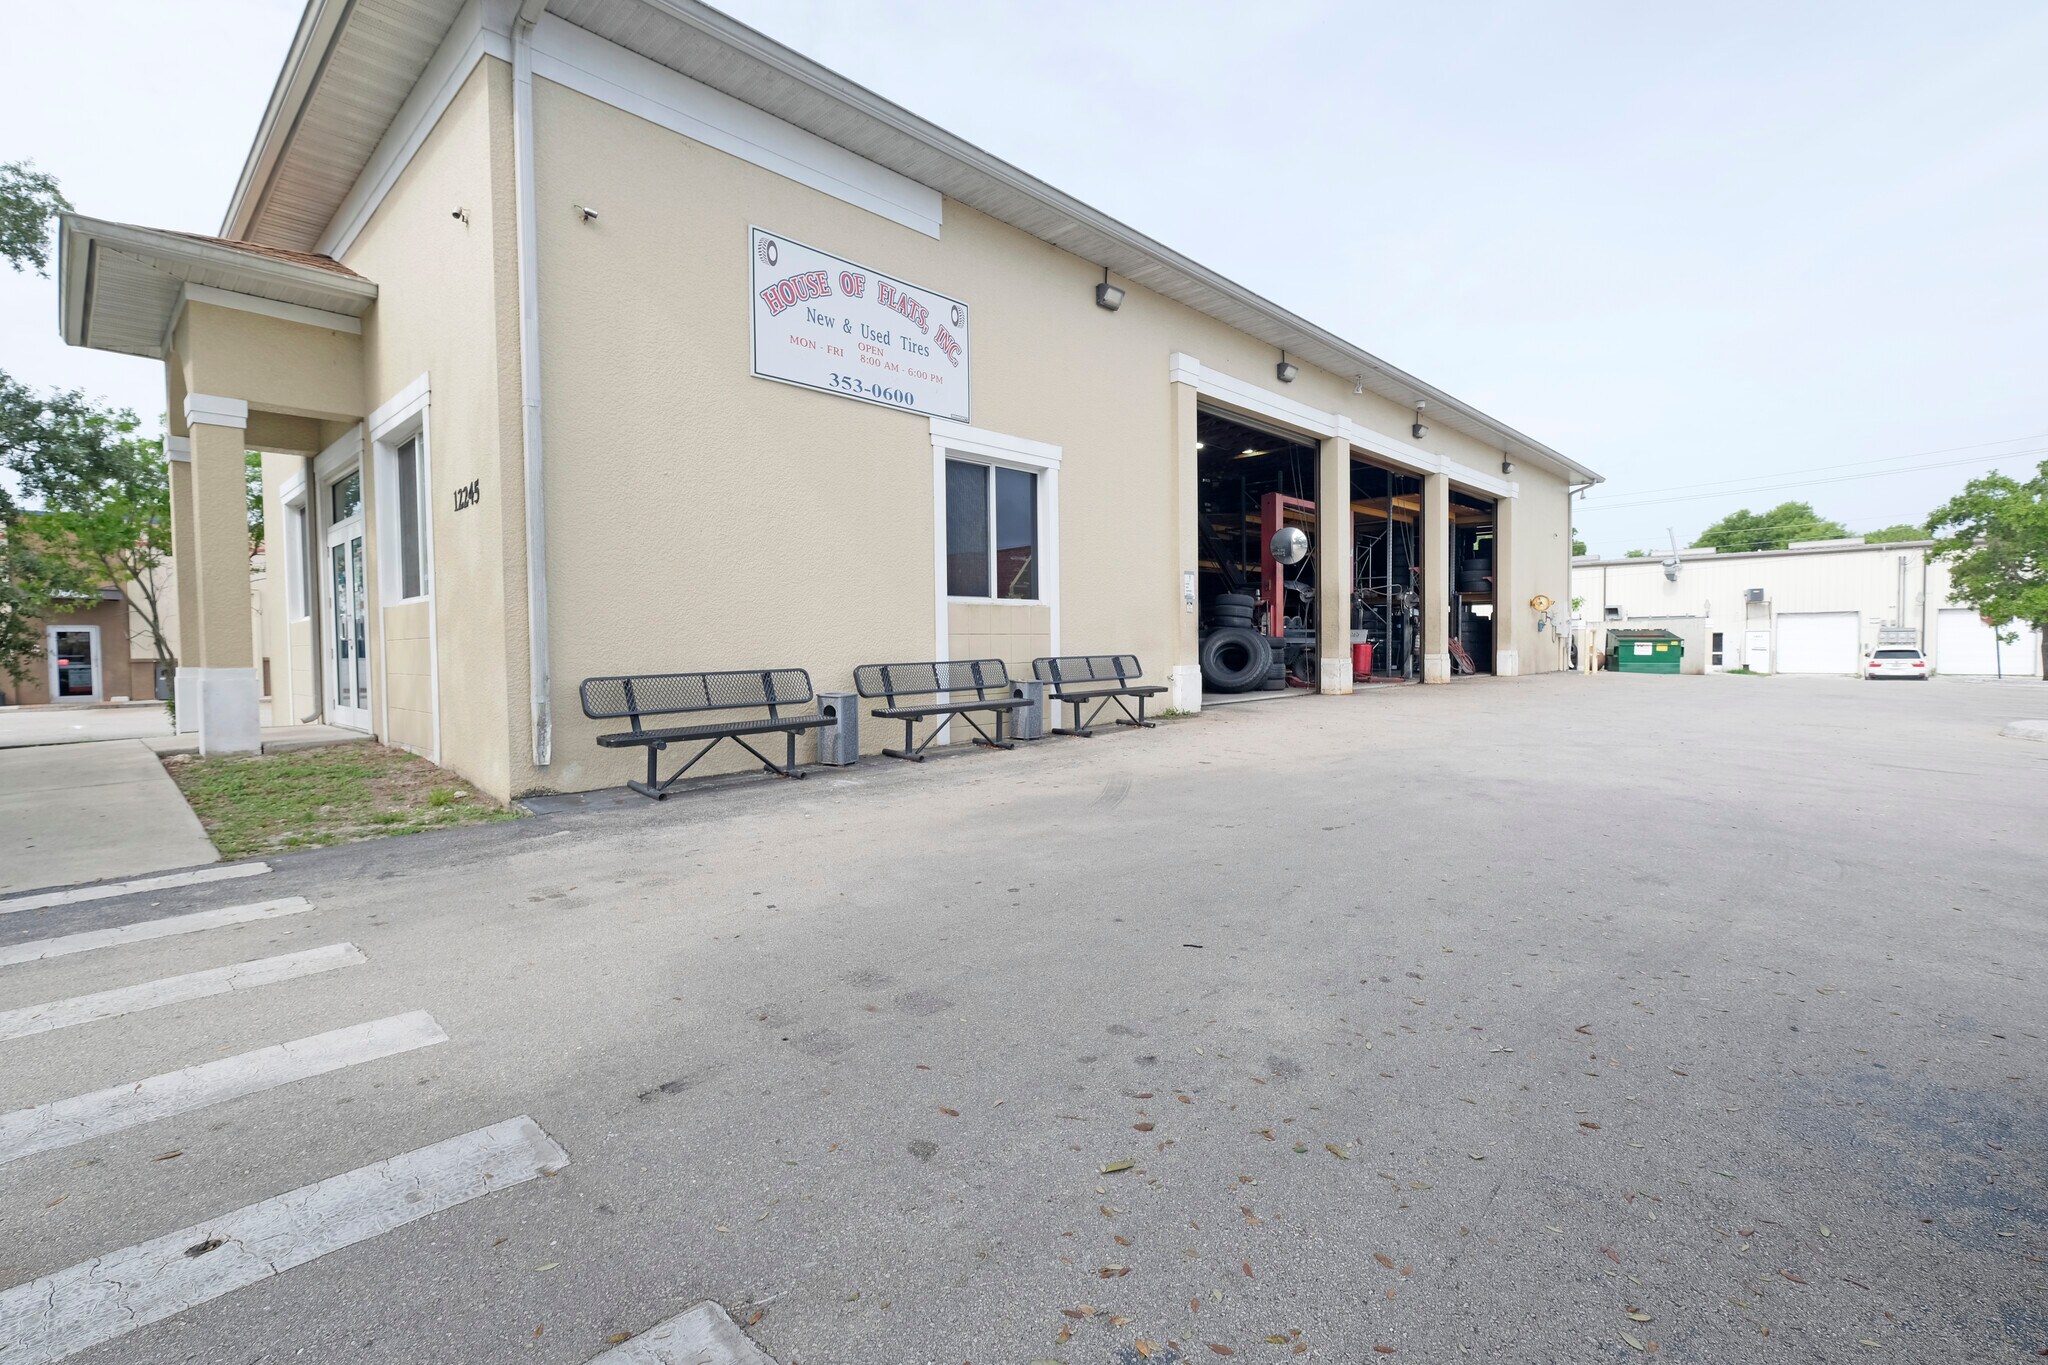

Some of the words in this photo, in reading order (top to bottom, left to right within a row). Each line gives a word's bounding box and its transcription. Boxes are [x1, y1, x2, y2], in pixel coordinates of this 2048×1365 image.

[760, 271, 832, 316] HOUSE
[839, 271, 866, 298] OF
[878, 281, 929, 335] FLATS,
[934, 324, 963, 367] INC.
[806, 307, 835, 328] New
[843, 319, 852, 334] &
[861, 324, 890, 346] Used
[900, 336, 929, 357] Tires
[789, 335, 816, 350] MON
[827, 345, 844, 357] FRI
[860, 354, 881, 367] 8:00
[884, 362, 899, 372] AM
[908, 367, 928, 380] 6:00
[930, 374, 943, 384] PM
[858, 343, 884, 357] OPEN
[829, 373, 914, 405] 353-0600
[453, 478, 480, 512] 12245
